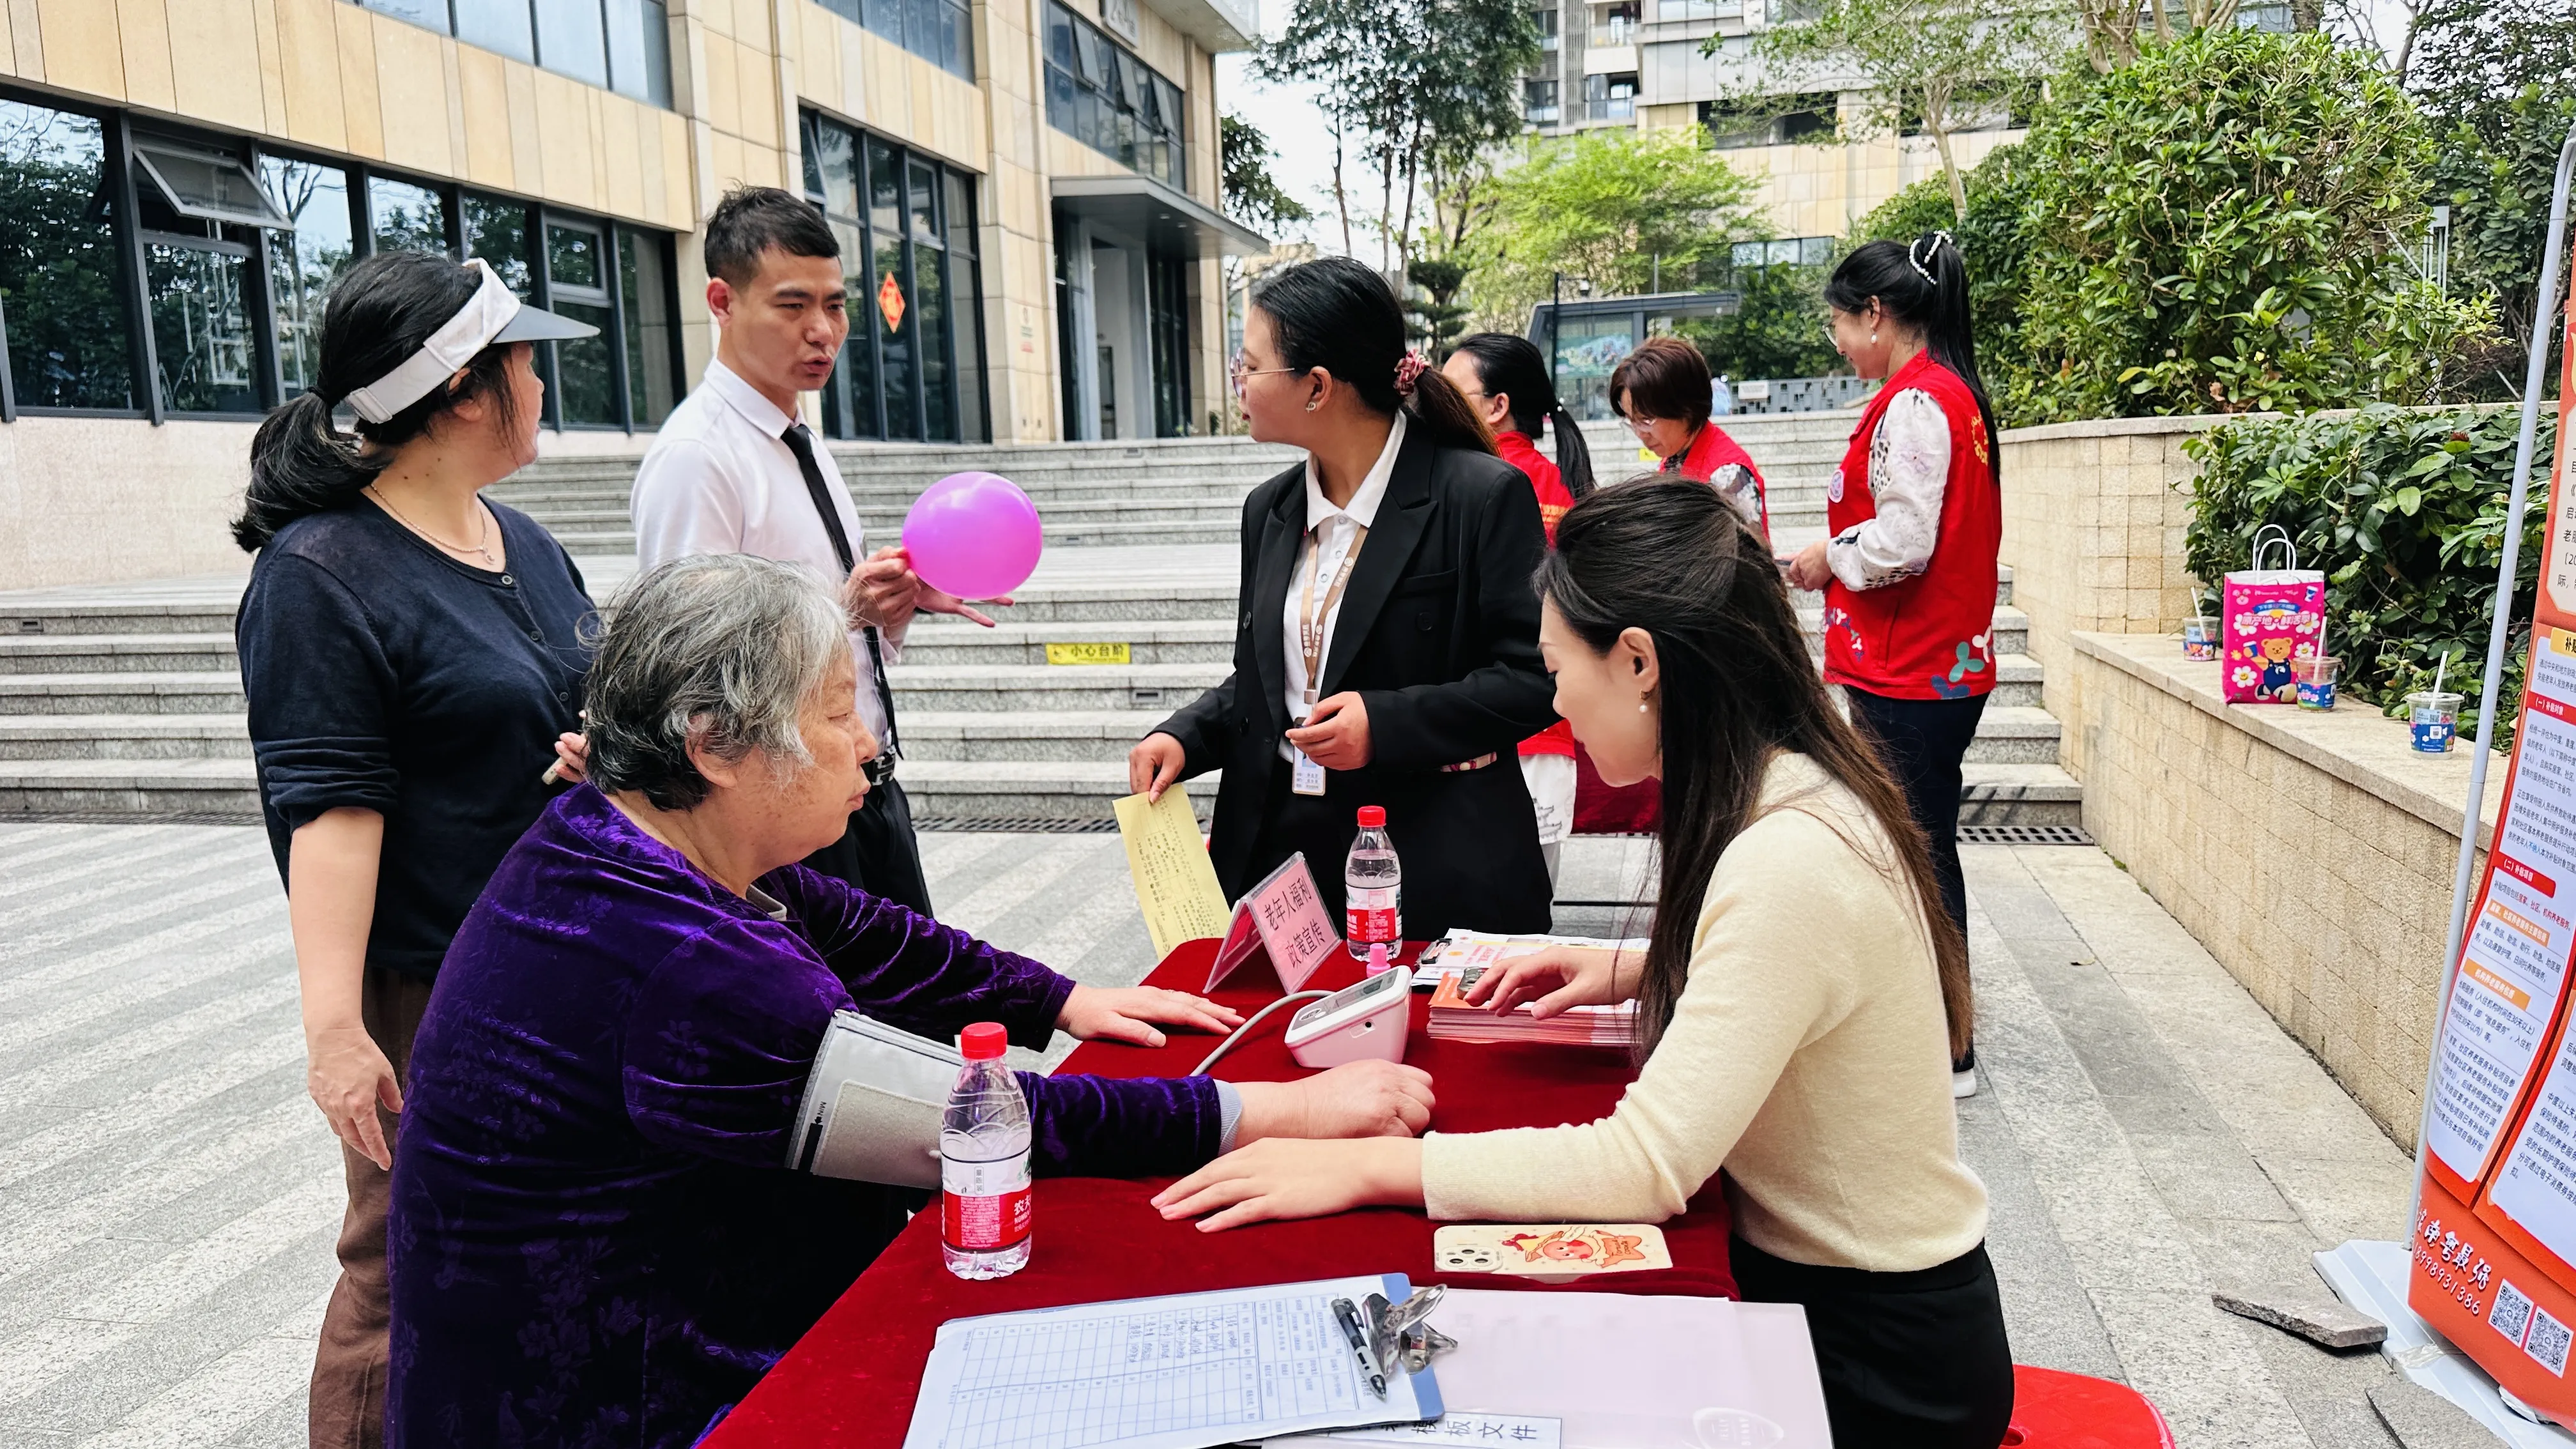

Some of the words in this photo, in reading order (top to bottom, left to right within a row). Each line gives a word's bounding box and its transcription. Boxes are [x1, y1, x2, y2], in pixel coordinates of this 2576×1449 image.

[1071, 644, 1124, 657] 小心台阶
[2539, 658, 2576, 678] 通过中央和地方财政
[1264, 875, 1312, 931] 老年人福利
[1285, 918, 1326, 969] 政策宣传
[2547, 1091, 2576, 1122] 中度以上失
[2524, 1137, 2576, 1184] 受的长期护理保险待
[1383, 1419, 1537, 1441] 模板文件
